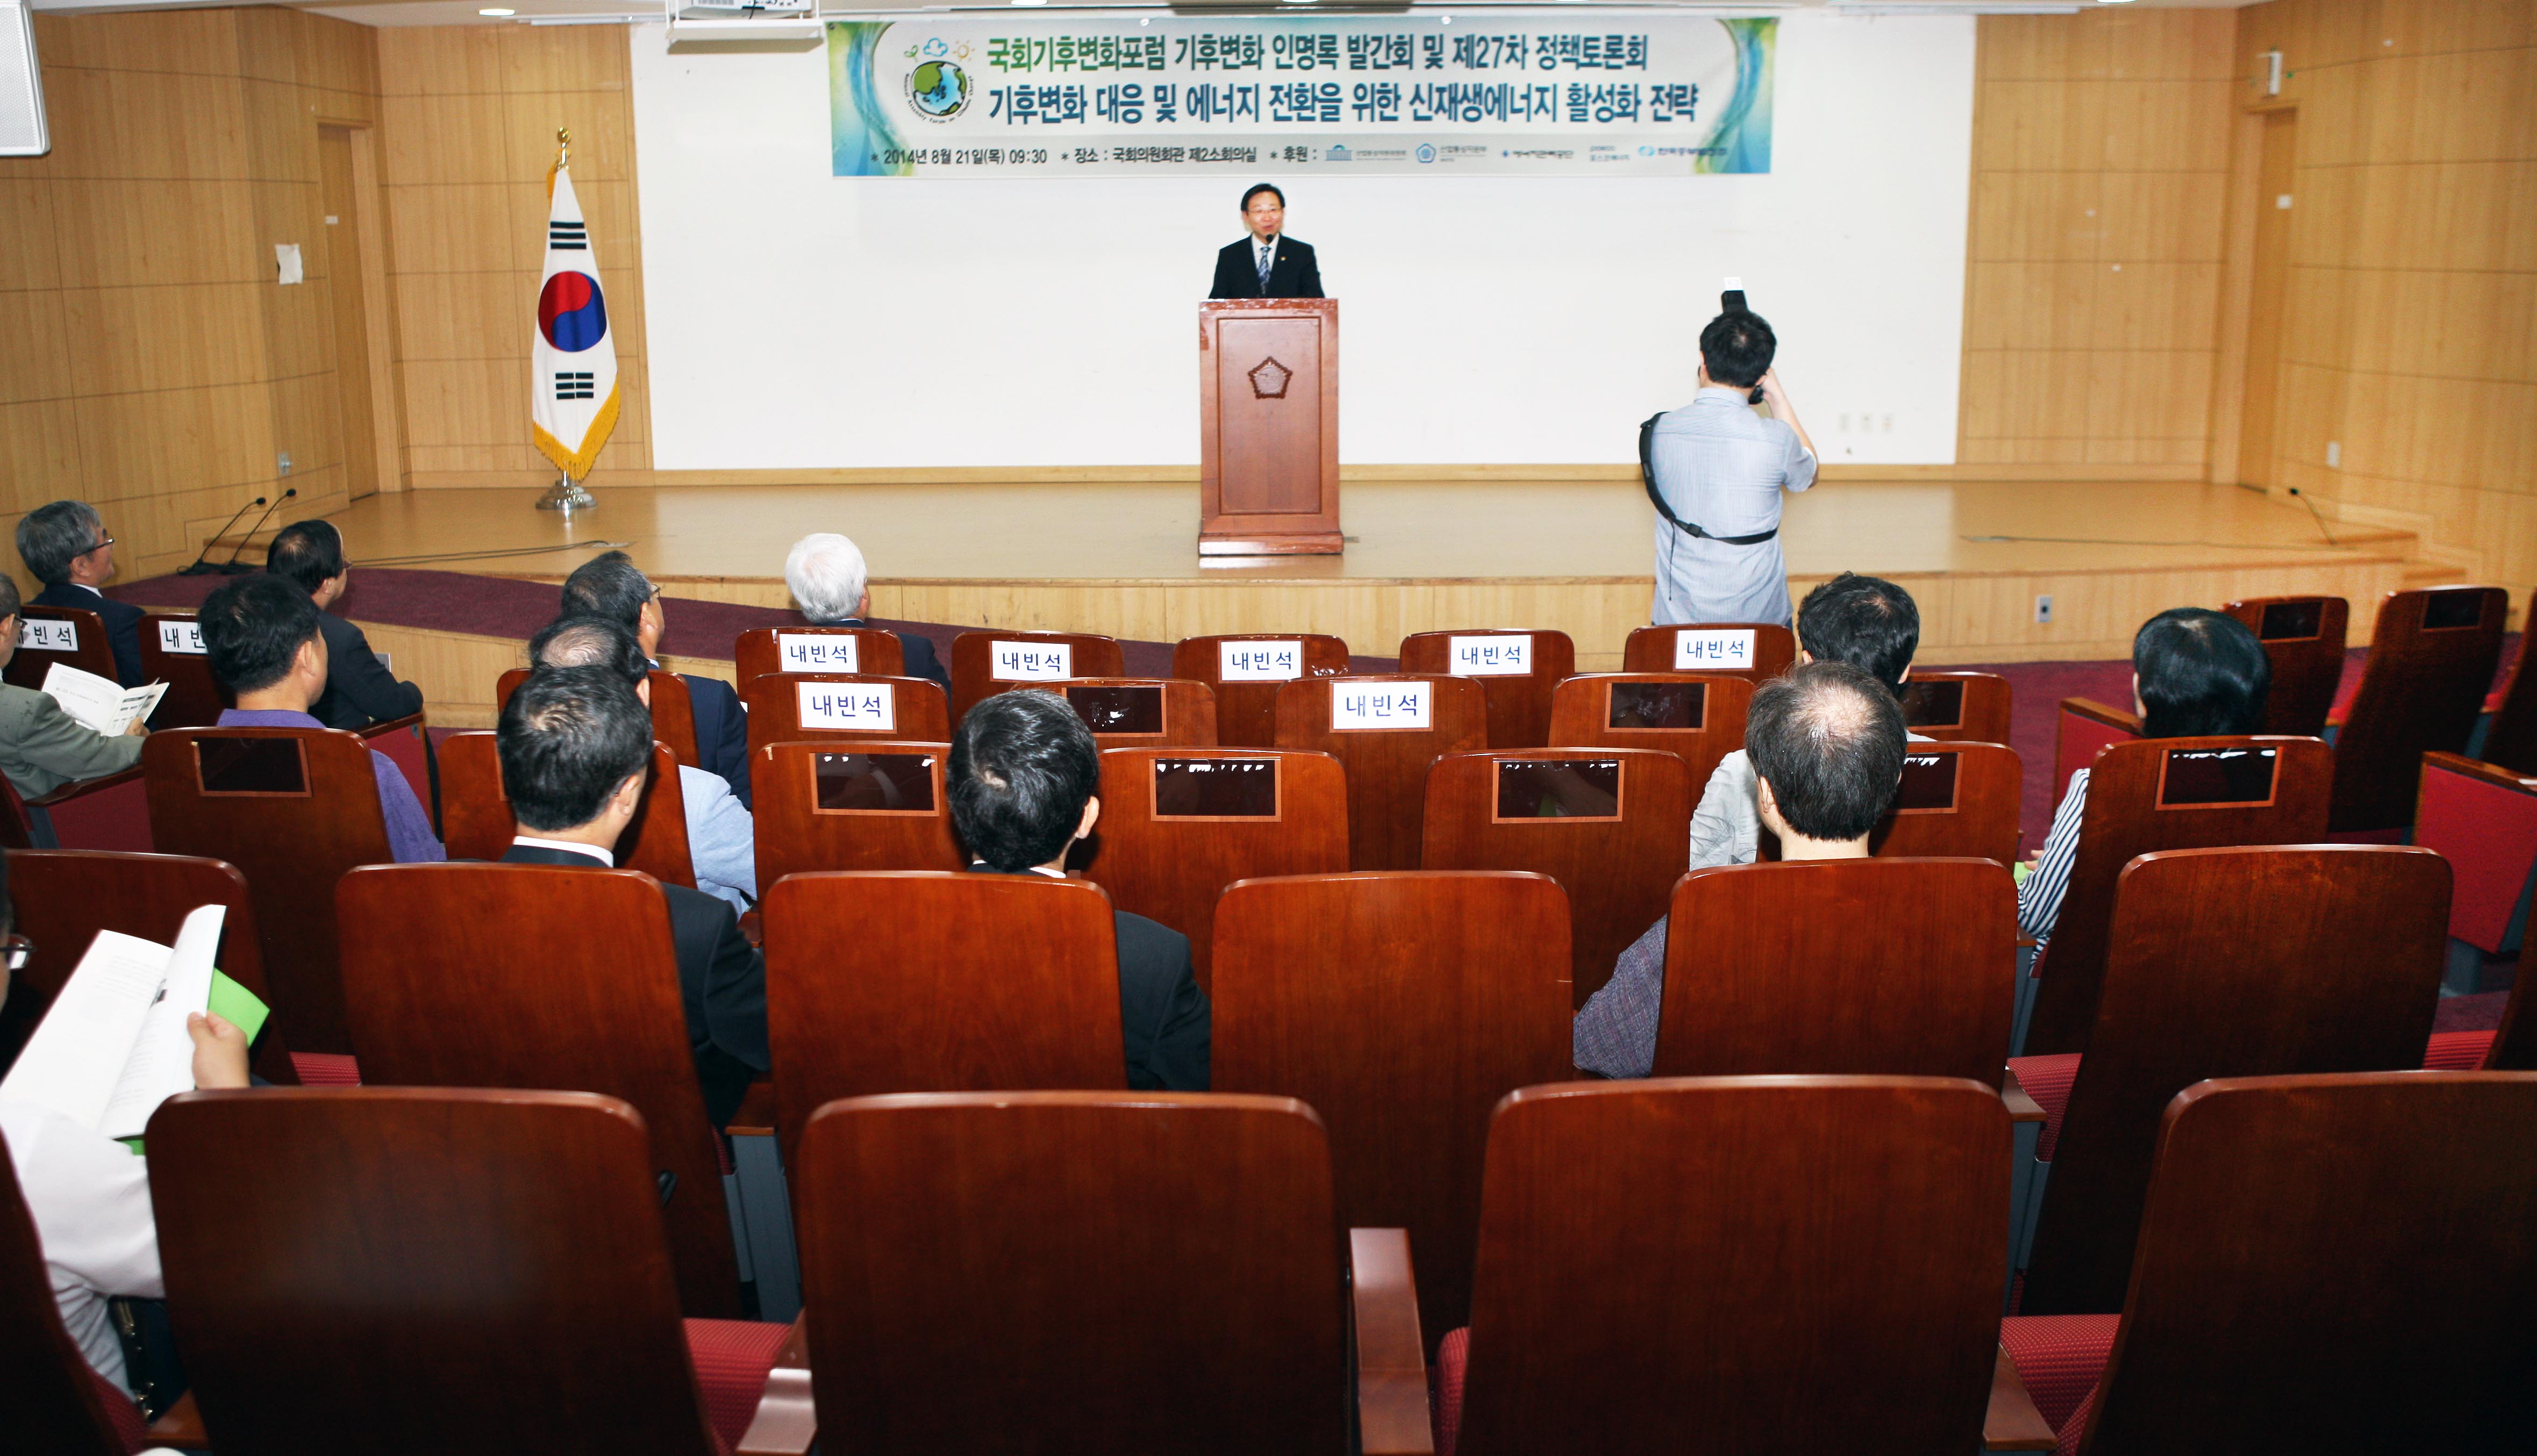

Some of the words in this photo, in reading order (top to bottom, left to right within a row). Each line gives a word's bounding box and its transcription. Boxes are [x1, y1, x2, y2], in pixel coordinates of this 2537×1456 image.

[988, 35, 1165, 73] 국회기후변화포럼
[1175, 34, 1264, 71] 기후변화
[1273, 33, 1340, 71] 인명록
[1347, 33, 1415, 71] 발간회
[1423, 33, 1445, 70] 및
[1452, 33, 1530, 70] 제27차
[1535, 34, 1648, 71] 정책토론회
[989, 85, 1087, 126] 기후변화
[1097, 84, 1146, 125] 대응
[1154, 84, 1177, 124] 및
[1187, 83, 1260, 124] 에너지
[1269, 83, 1344, 123] 전환을
[1352, 83, 1402, 123] 위한
[1409, 83, 1557, 123] 신재생에너지
[1566, 83, 1642, 124] 활성화
[1649, 83, 1700, 123] 전략
[884, 149, 927, 166] 2014년
[932, 149, 952, 165] 8월
[956, 148, 1006, 166] 21일(목)
[1010, 149, 1048, 164] 09:30
[1075, 148, 1100, 164] 장소
[1113, 147, 1185, 164] 국회의원회관
[1189, 147, 1257, 163] 제2소회의실
[1283, 147, 1309, 163] 후원
[165, 628, 206, 649] 내빈
[1686, 640, 1744, 659] 내빈석
[791, 645, 848, 664] 내빈석
[1002, 651, 1061, 673] 내빈석
[1232, 650, 1292, 672] 내빈석
[1461, 645, 1521, 666] 내빈석
[812, 695, 882, 719] 내빈석
[1346, 693, 1418, 719] 내빈석
